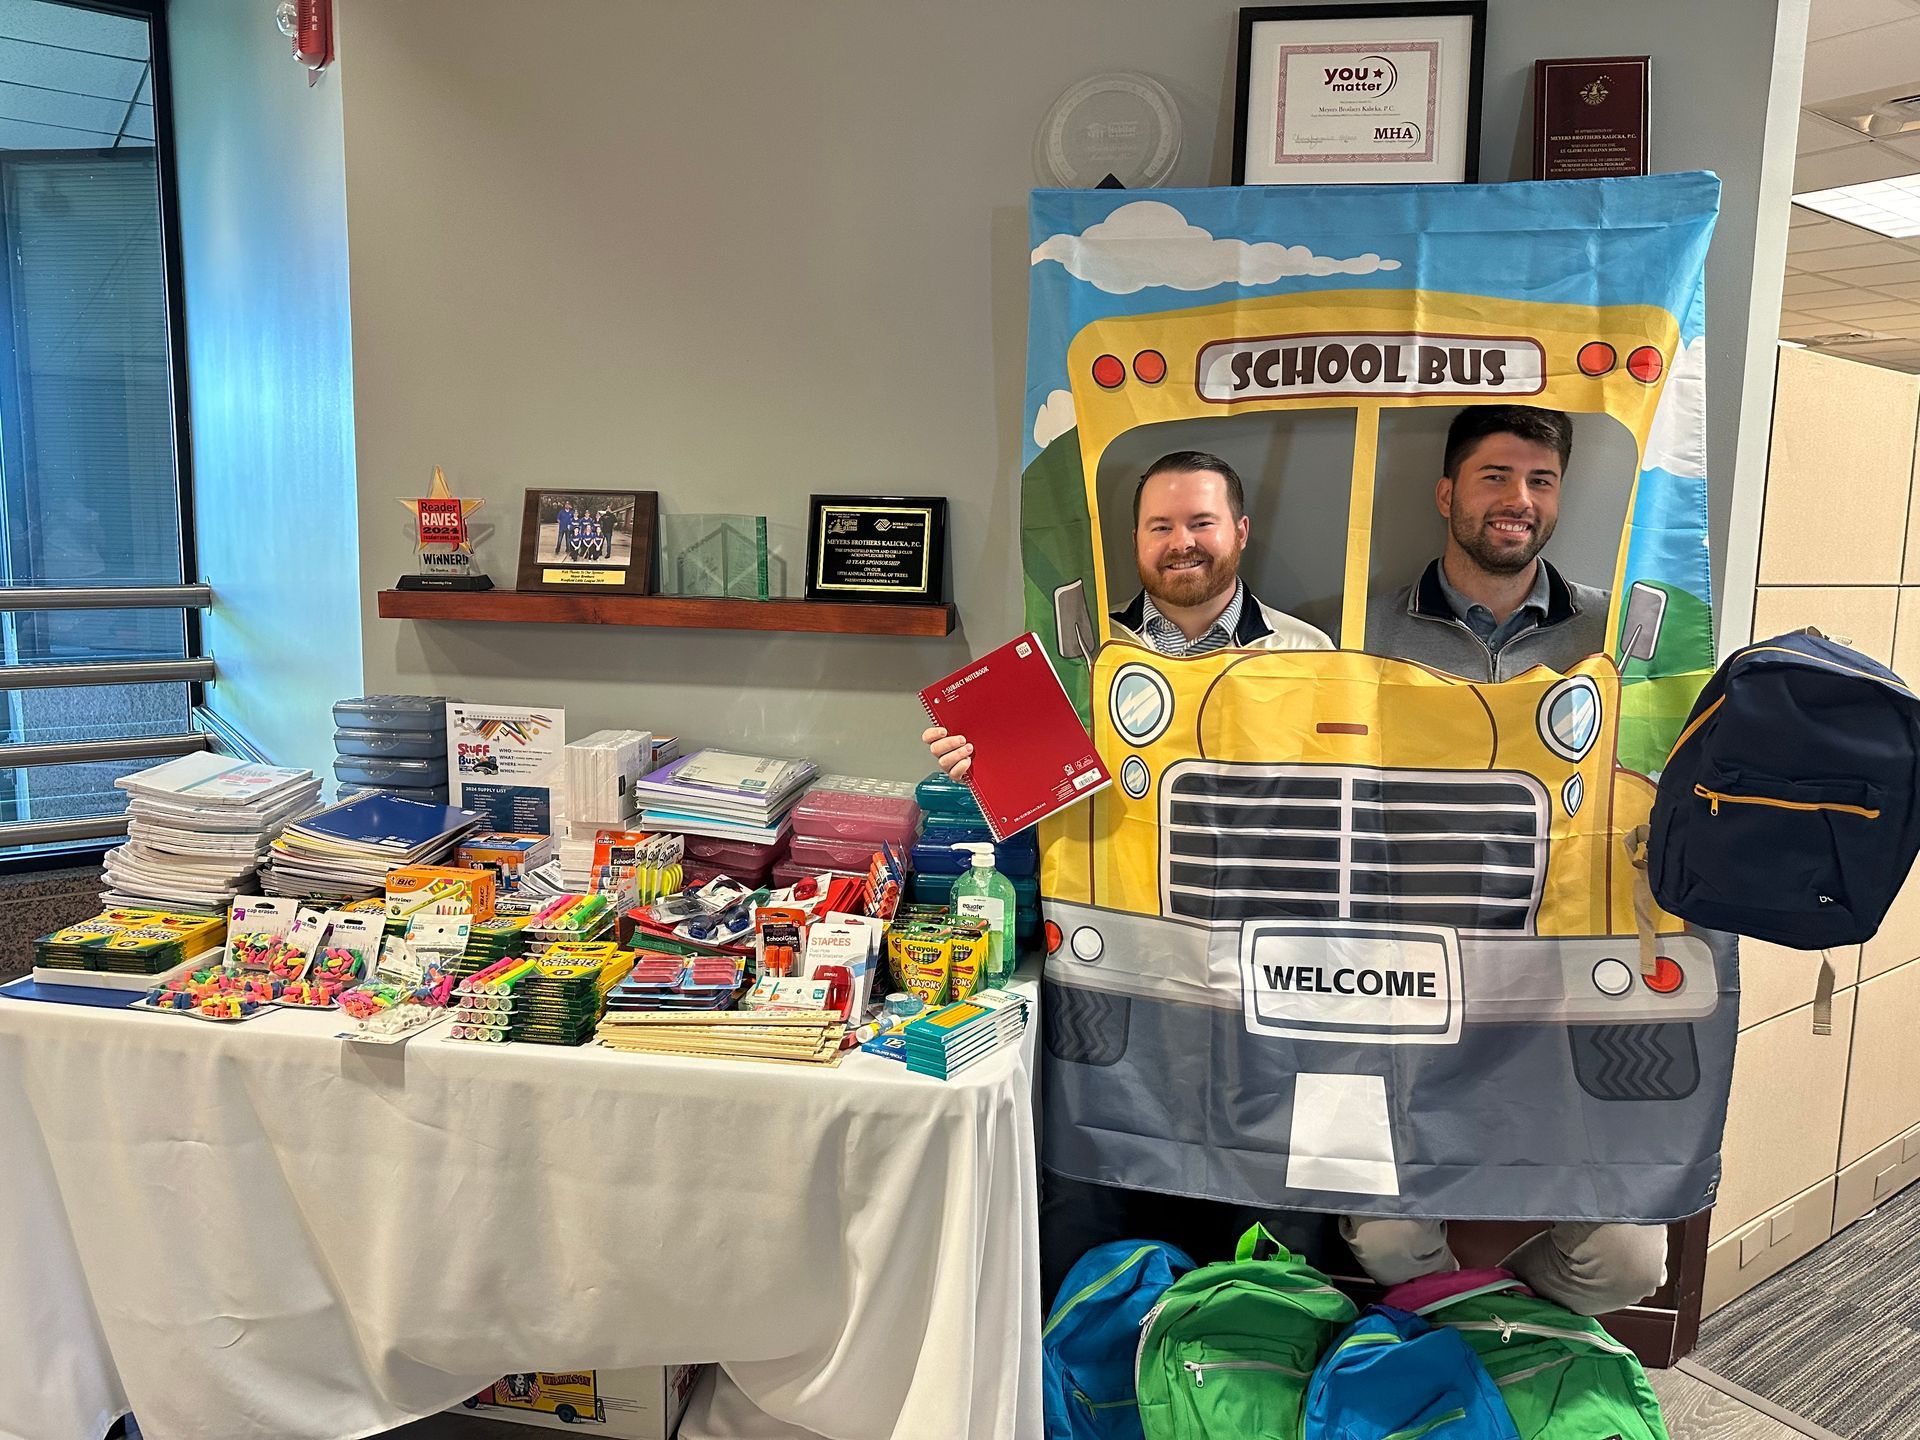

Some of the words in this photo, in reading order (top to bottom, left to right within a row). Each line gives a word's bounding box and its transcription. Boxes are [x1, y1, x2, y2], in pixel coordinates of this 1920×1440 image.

[1324, 67, 1369, 85] you
[1332, 82, 1382, 92] matter
[1373, 127, 1414, 140] MHA
[1231, 343, 1407, 391] SCHOOL
[1418, 345, 1506, 386] BUS
[421, 502, 457, 512] Reader
[422, 512, 459, 526] RAVES
[942, 678, 965, 695] 1-SUBJECT
[965, 666, 990, 682] NOTEBOOK
[458, 744, 490, 756] Stuff
[811, 938, 851, 946] STAPLES
[908, 944, 938, 952] Crayola
[906, 978, 942, 990] CRAYONS
[1263, 964, 1436, 998] WELCOME
[882, 1038, 906, 1048] 12
